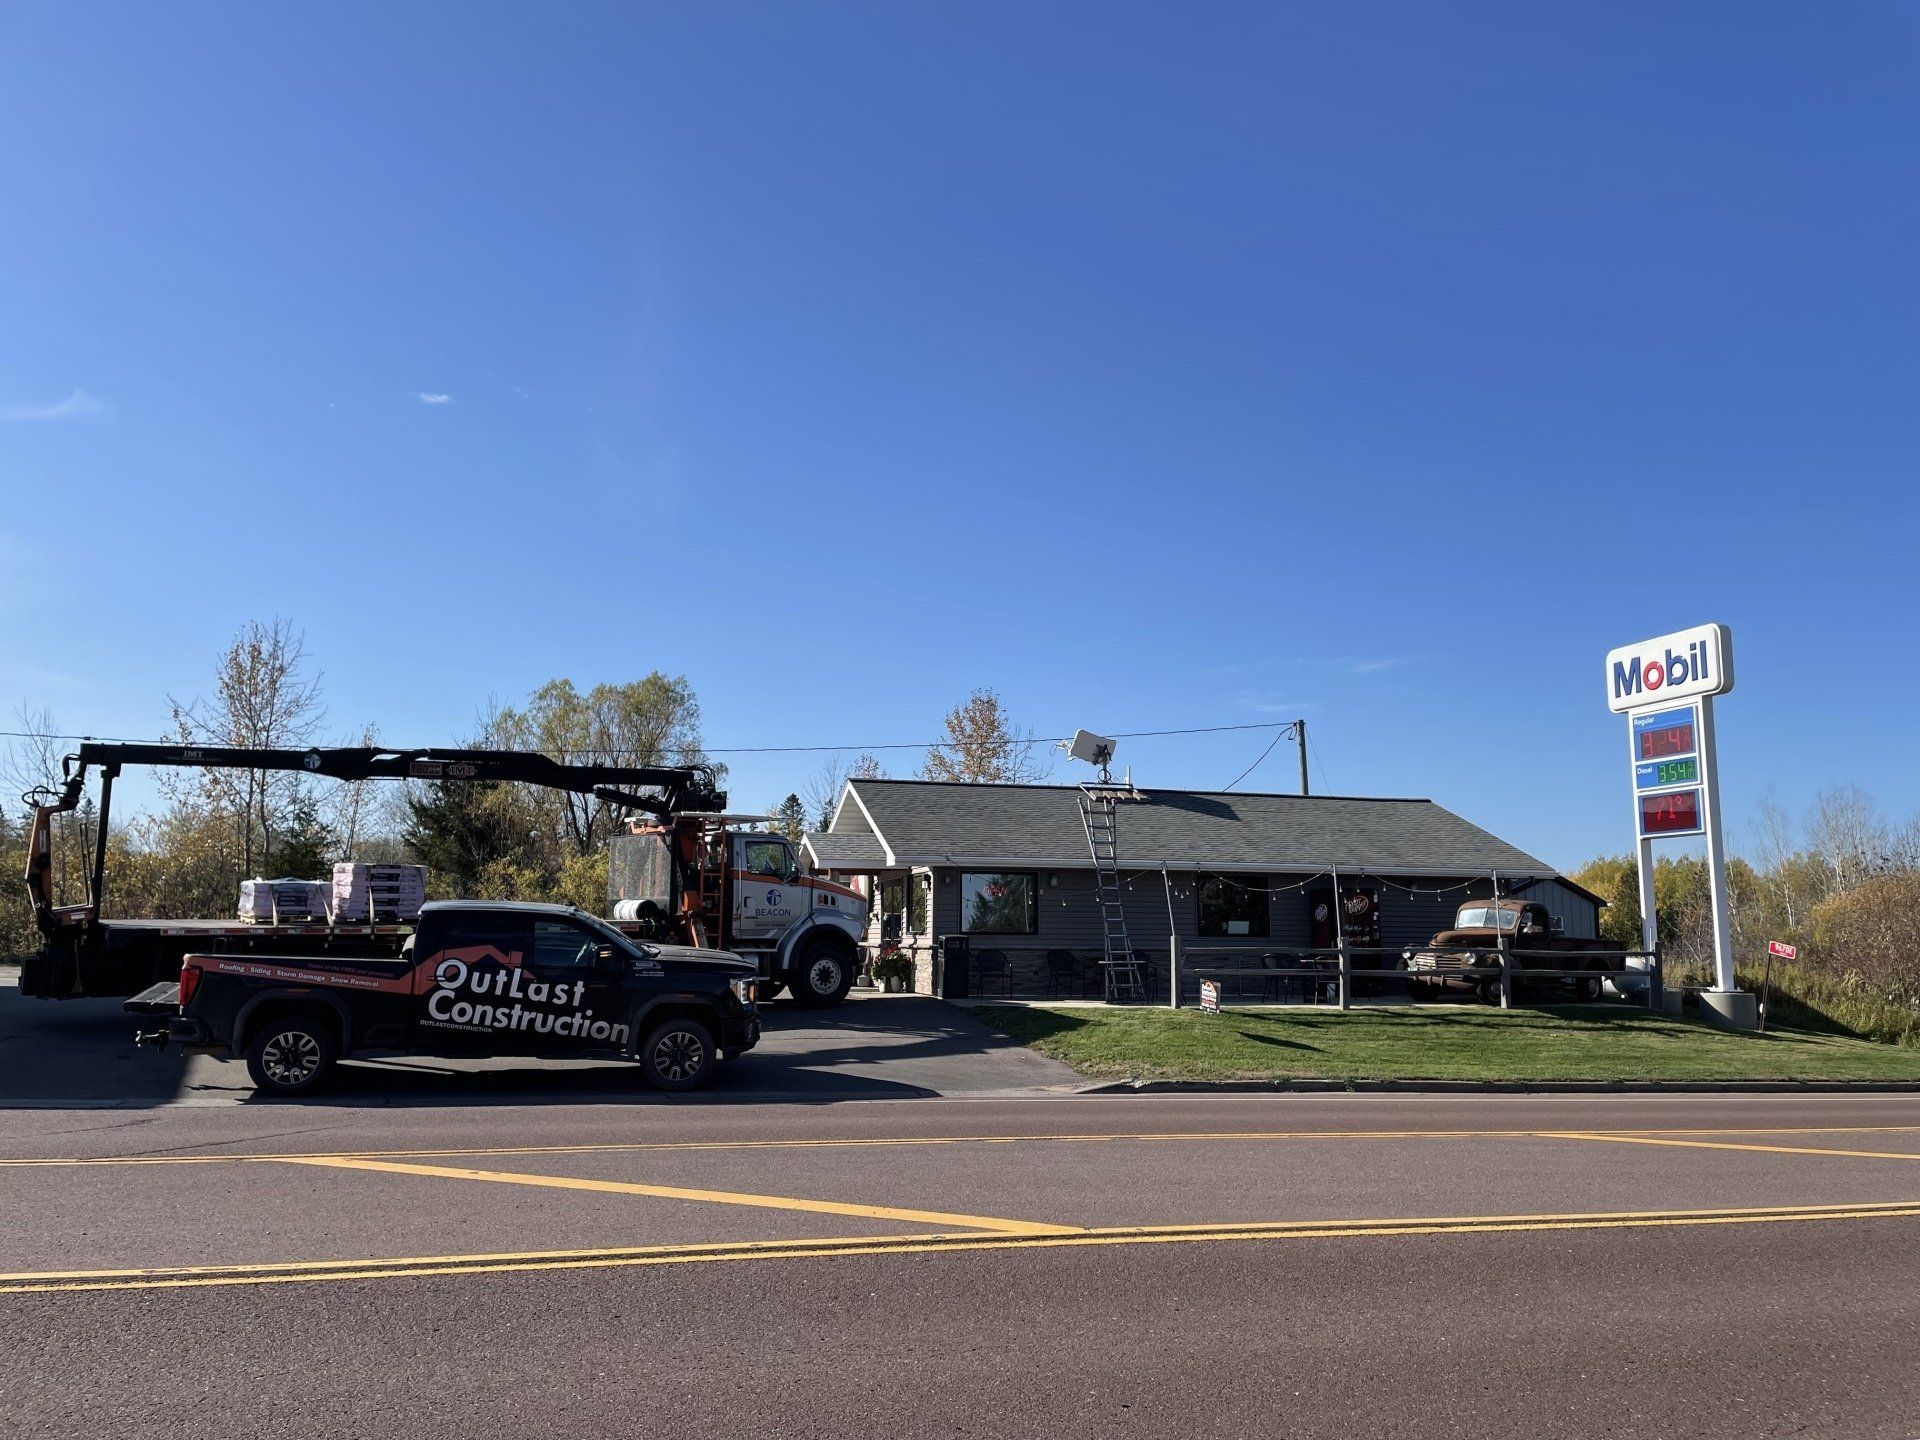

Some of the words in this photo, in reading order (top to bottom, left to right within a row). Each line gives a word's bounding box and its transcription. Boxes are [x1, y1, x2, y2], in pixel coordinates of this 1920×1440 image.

[1613, 639, 1708, 698] Mobil
[1633, 716, 1655, 727] Regular
[183, 750, 203, 758] IMT
[1637, 765, 1653, 775] Diesel
[983, 884, 1008, 896] OPEN
[755, 908, 791, 916] BEACON
[219, 963, 245, 973] Roofing
[250, 966, 272, 976] Siding
[276, 970, 297, 978] Storm
[298, 972, 326, 982] Damage
[331, 976, 349, 984] Snow
[350, 978, 380, 988] Removal
[436, 959, 585, 1007] OutLast
[428, 989, 631, 1044] Construction
